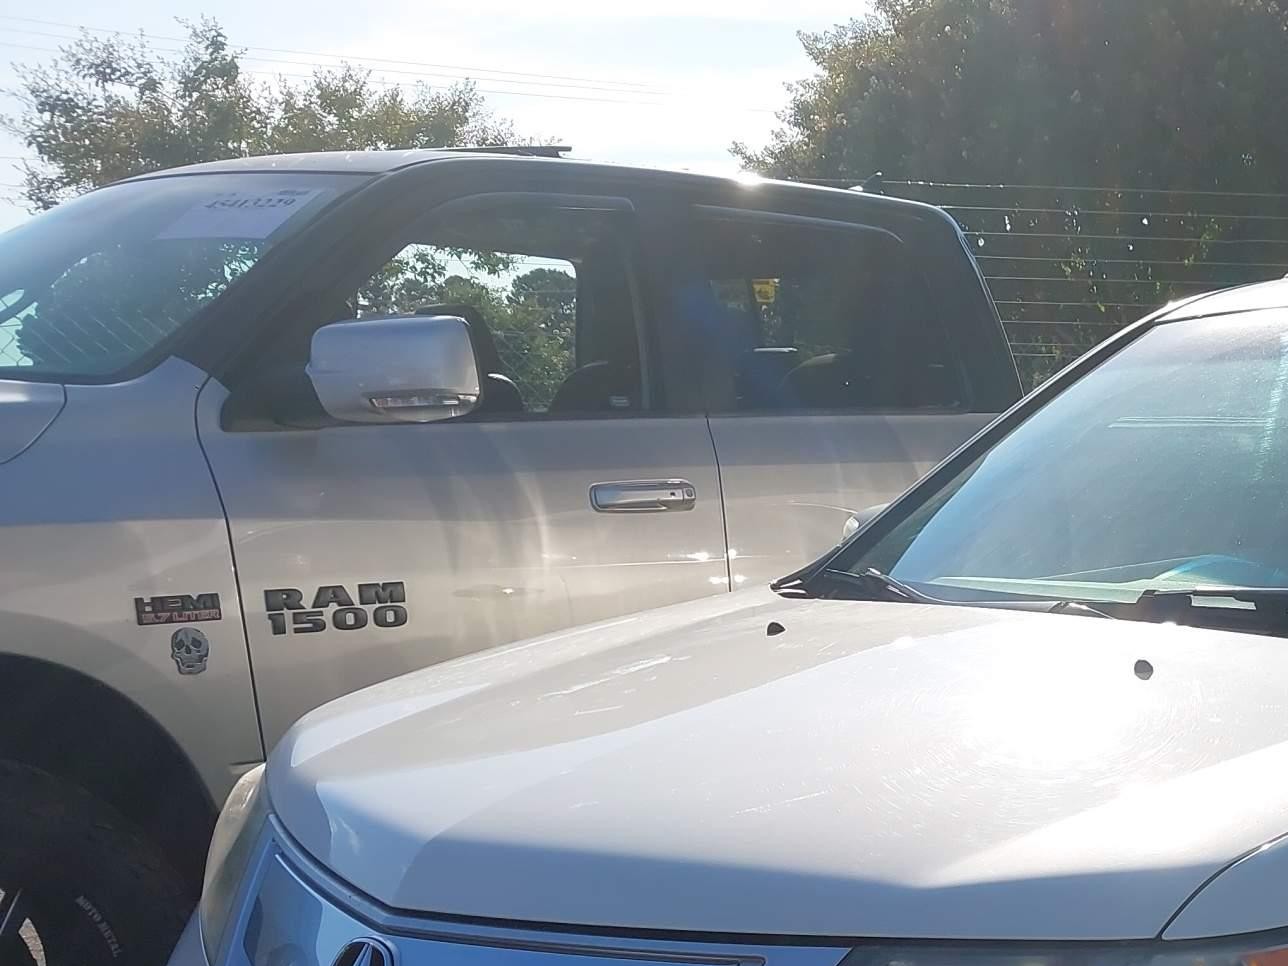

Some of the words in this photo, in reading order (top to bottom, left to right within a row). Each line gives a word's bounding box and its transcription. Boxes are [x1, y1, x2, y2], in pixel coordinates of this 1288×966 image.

[134, 592, 221, 614] HEMI
[263, 581, 406, 611] RAM
[171, 608, 220, 622] LITER
[267, 605, 408, 635] 1500
[75, 895, 102, 922] MOTO
[96, 921, 123, 958] METAL
